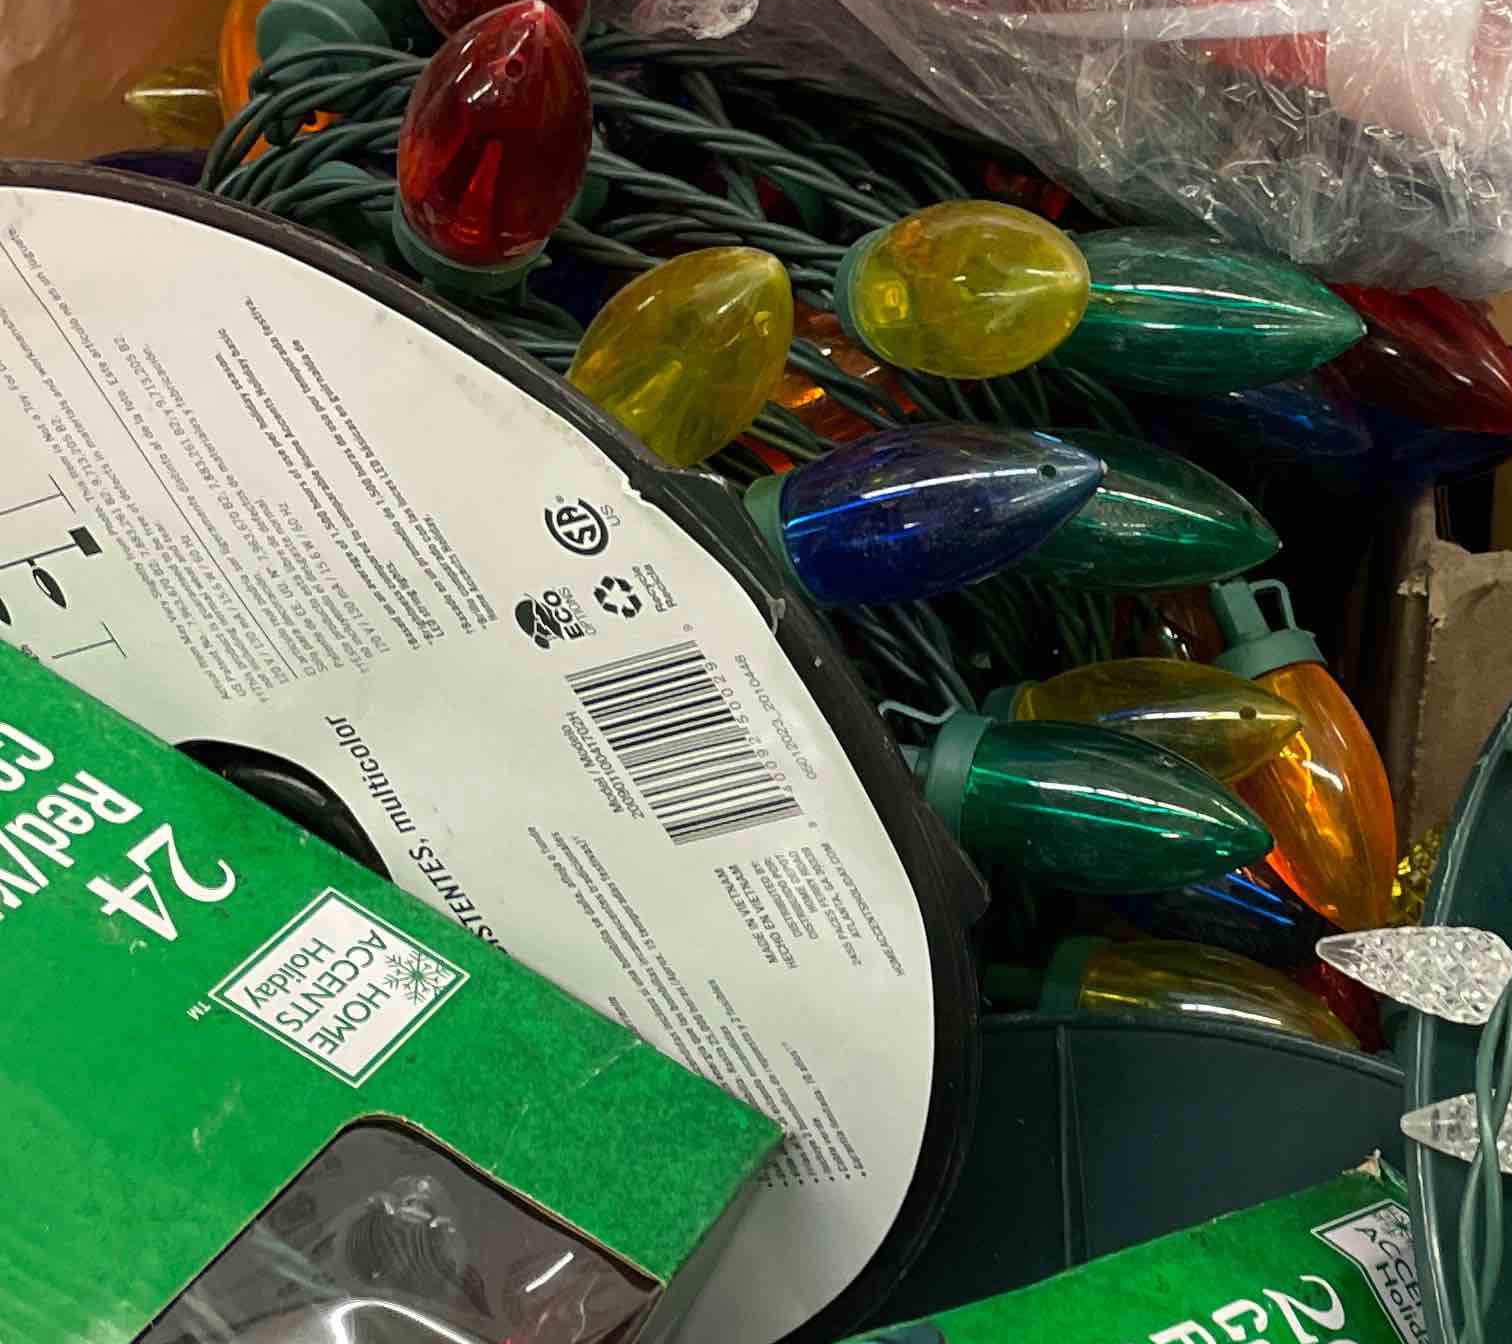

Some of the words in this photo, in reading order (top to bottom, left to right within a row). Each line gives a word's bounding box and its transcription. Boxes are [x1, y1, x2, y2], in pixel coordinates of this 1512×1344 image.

[236, 357, 267, 397] Holiday
[262, 397, 295, 438] Accents
[543, 591, 584, 640] ECO
[560, 723, 595, 768] Modelo
[324, 714, 415, 834] multicolor
[592, 776, 624, 813] Model
[86, 823, 236, 942] 24
[713, 867, 750, 916] VIETNAM
[727, 863, 765, 913] VIETNAM
[751, 931, 778, 963] MADE
[768, 931, 797, 969] HECHO
[243, 937, 335, 1009] Holiday
[275, 929, 388, 1034] ACCENTS
[187, 1000, 211, 1021] TM
[307, 982, 391, 1056] HOME
